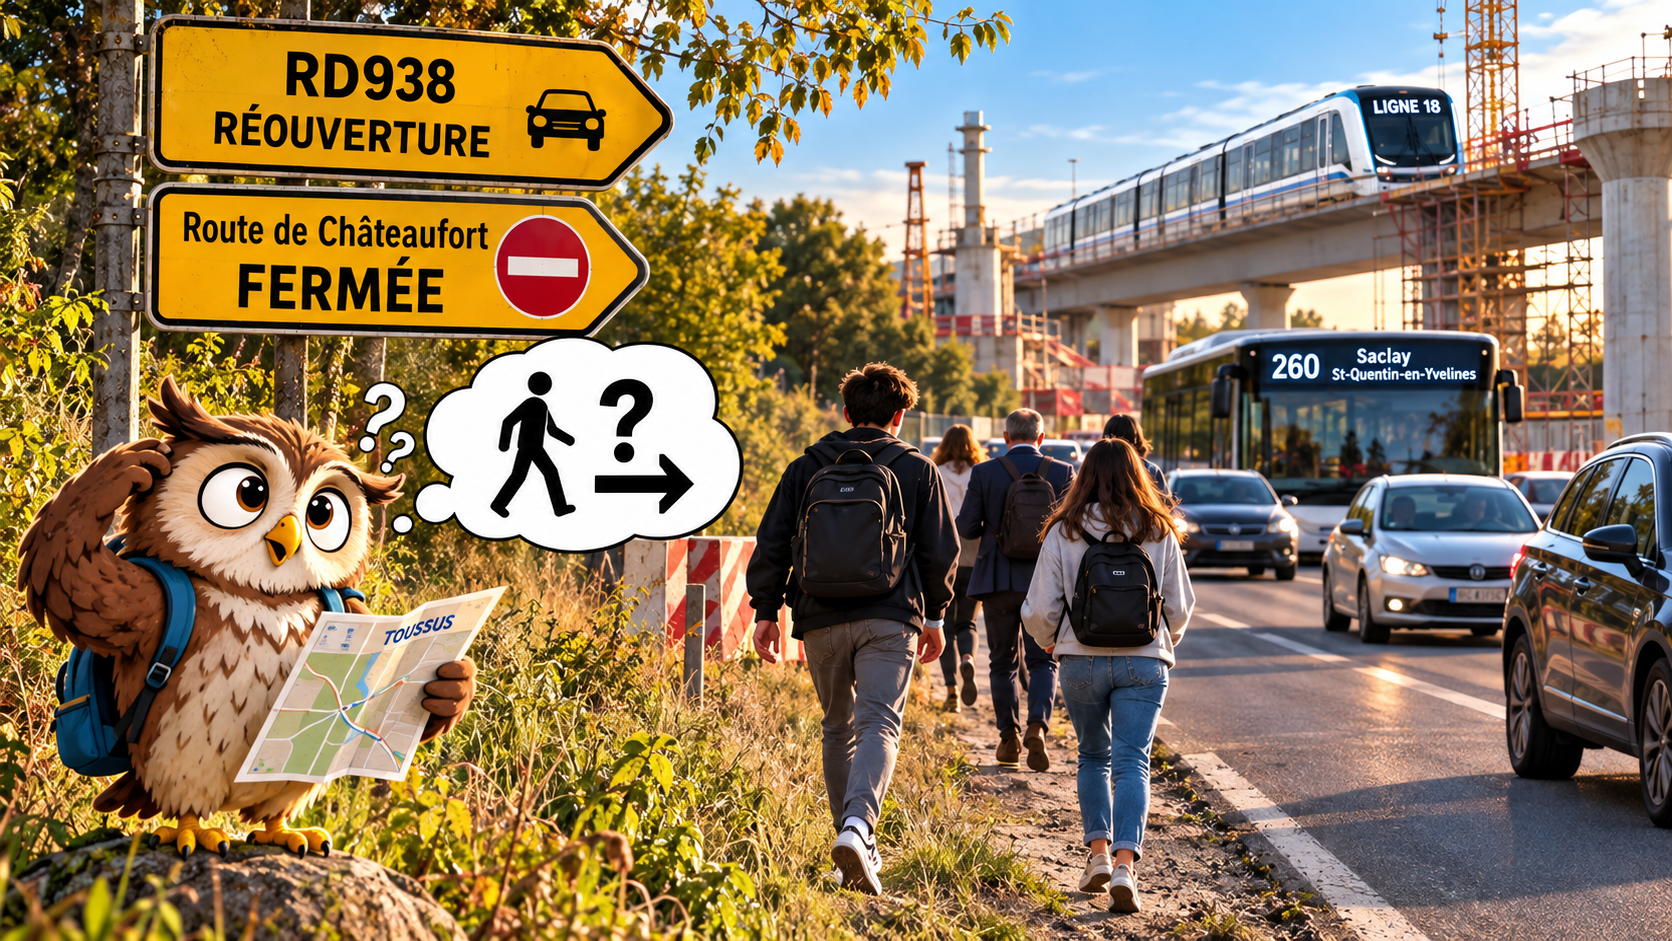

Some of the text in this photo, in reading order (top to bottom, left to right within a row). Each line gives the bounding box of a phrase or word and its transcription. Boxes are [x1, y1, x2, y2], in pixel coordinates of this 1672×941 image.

[285, 50, 456, 104] RD938
[1372, 99, 1441, 115] LIGNE 18
[213, 104, 491, 159] RÉOUVERTURE
[183, 211, 489, 251] Route de Châteaufort
[237, 256, 445, 314] FERMÉE
[1271, 353, 1320, 380] 260
[1356, 347, 1412, 367] Saclay
[1332, 367, 1477, 382] St-Quentin-en-Yvelines
[383, 614, 456, 646] TOUSSUS
